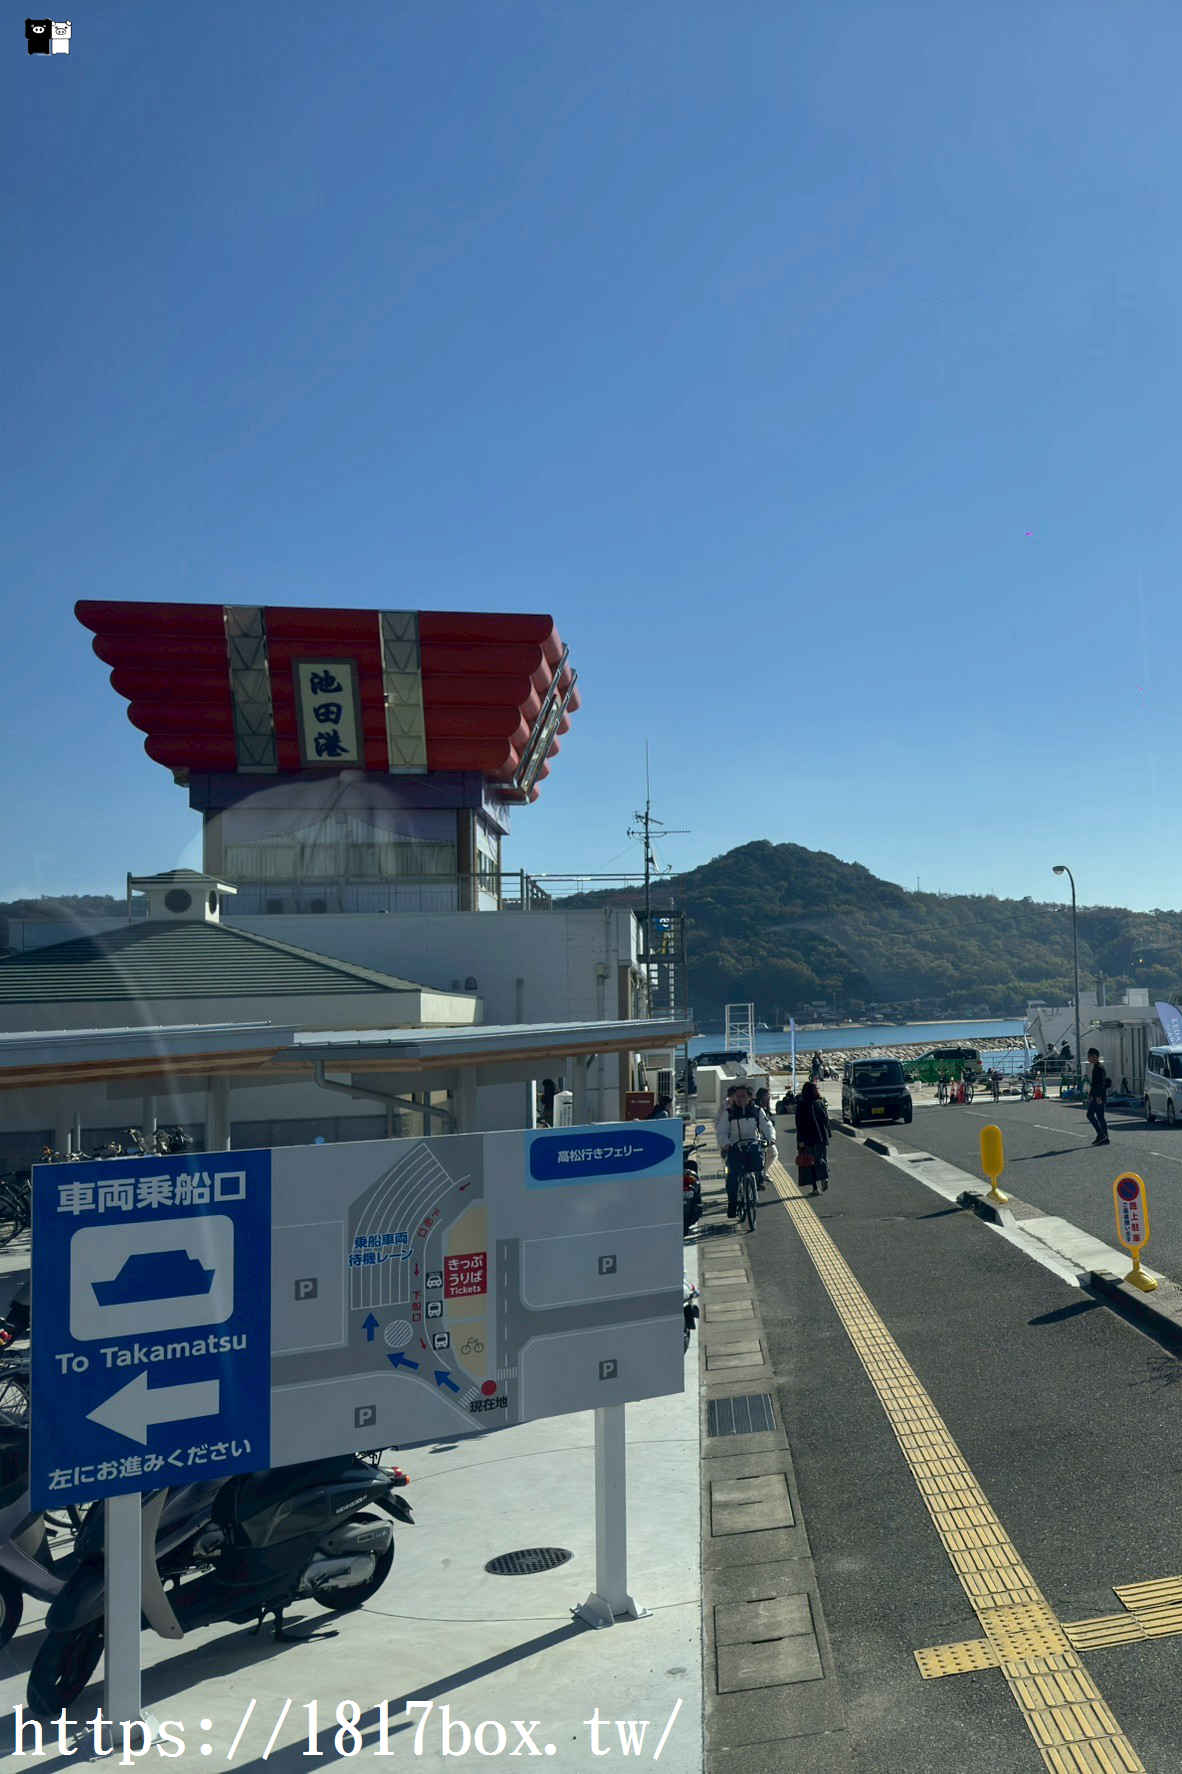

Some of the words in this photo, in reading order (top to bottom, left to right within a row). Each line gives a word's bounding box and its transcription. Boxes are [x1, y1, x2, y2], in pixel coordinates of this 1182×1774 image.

[310, 669, 350, 757] 池田港
[557, 1144, 644, 1164] 高松行きフェリー
[56, 1170, 247, 1216] 車両乗船口
[447, 1255, 484, 1272] きっぷ
[448, 1271, 483, 1287] うりば
[449, 1285, 482, 1296] Tickets
[56, 1352, 90, 1375] To
[101, 1334, 248, 1368] Takamatsu
[470, 1396, 509, 1413] 現在地
[47, 1438, 252, 1491] 左にお進みください
